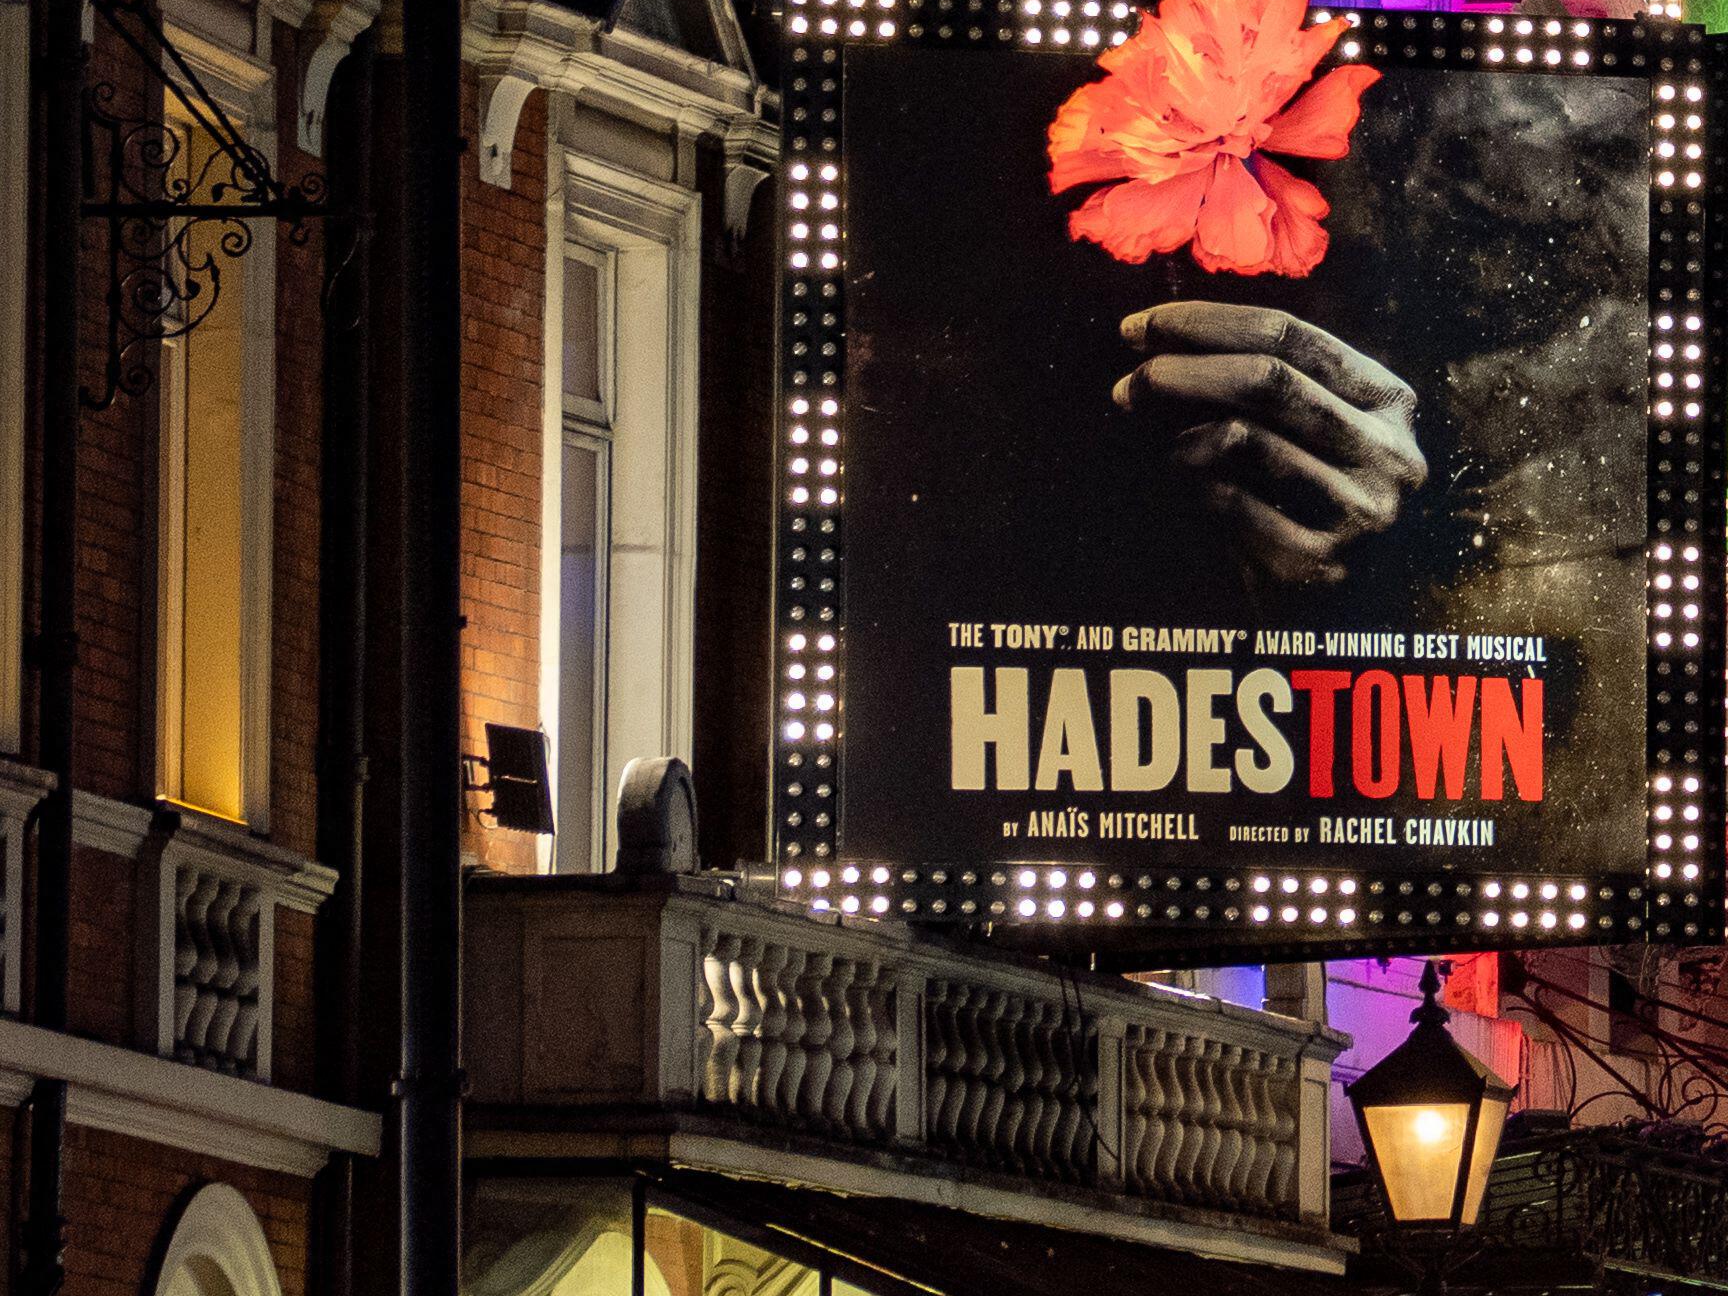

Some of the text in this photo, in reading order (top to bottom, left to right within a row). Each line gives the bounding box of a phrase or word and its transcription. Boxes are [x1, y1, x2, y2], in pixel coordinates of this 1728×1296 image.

[949, 623, 983, 647] THE
[1077, 627, 1113, 651] AND
[1255, 630, 1405, 659] AWARD-WINNING
[1414, 634, 1459, 659] BEST
[1467, 635, 1546, 662] MUSICAL
[950, 666, 1544, 802] HADESTOWN
[1003, 806, 1494, 847] BY ANAÏS MITCHELL DIRECTED BY RACHEL CHAVKIN
